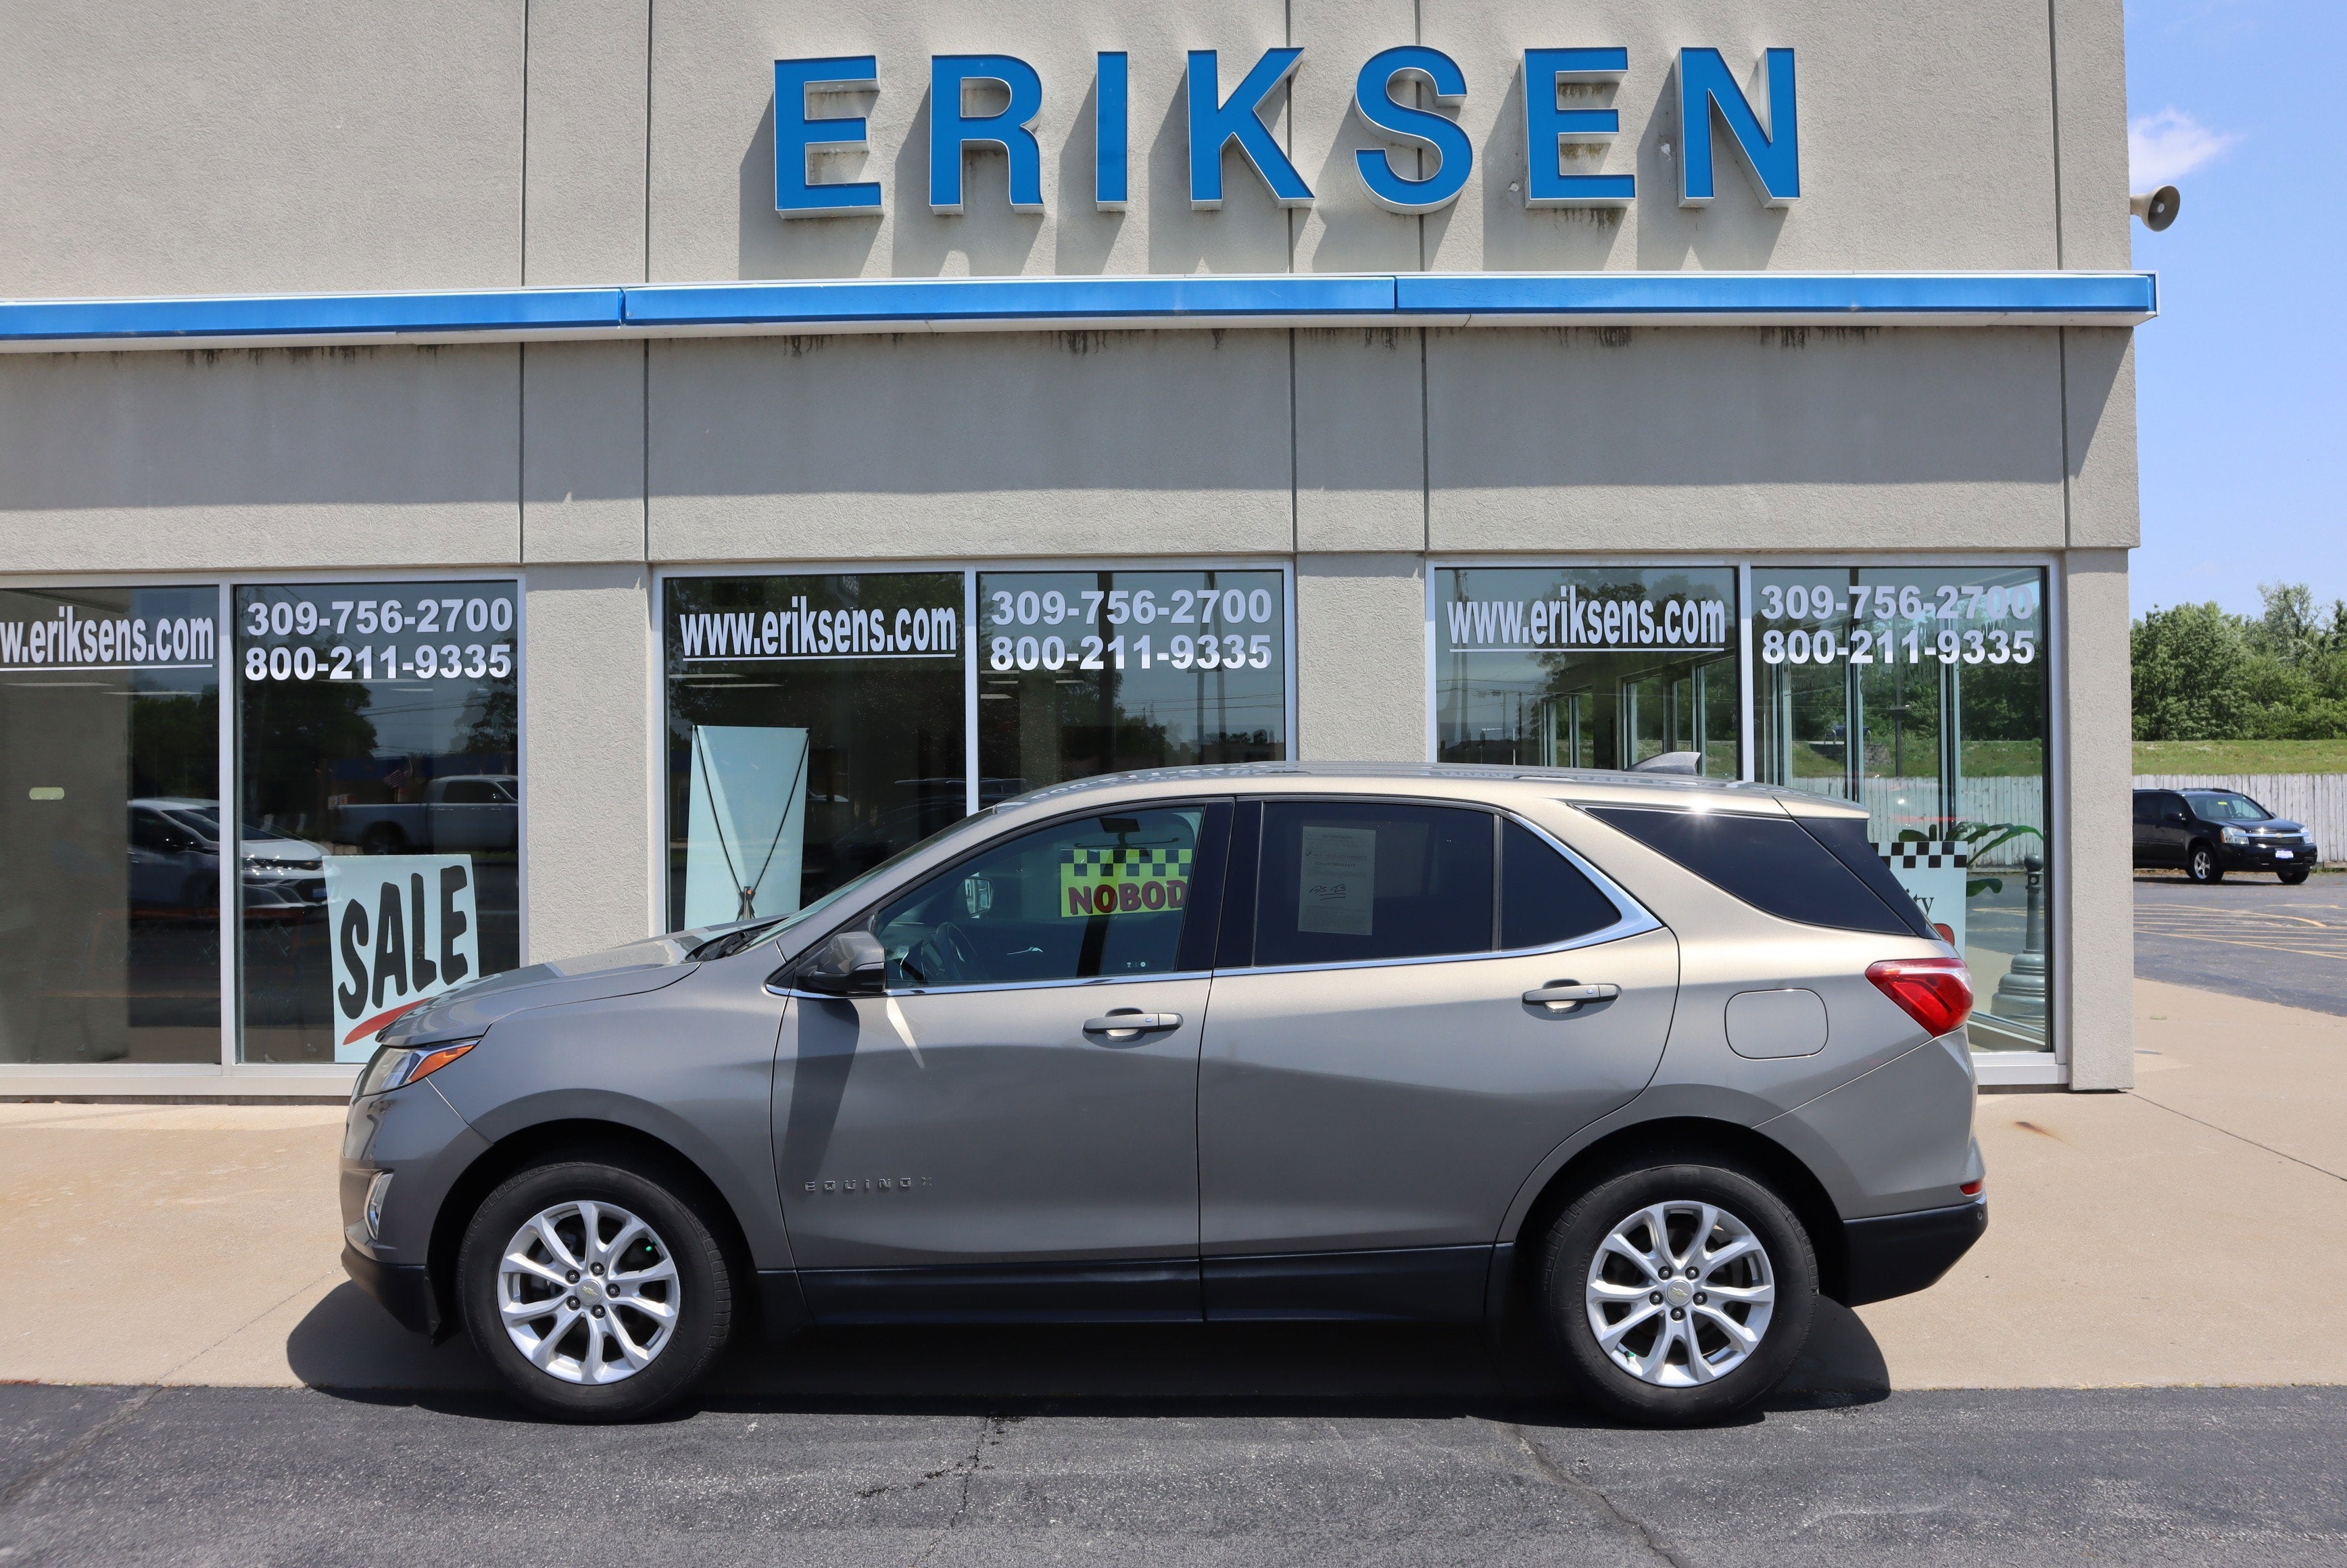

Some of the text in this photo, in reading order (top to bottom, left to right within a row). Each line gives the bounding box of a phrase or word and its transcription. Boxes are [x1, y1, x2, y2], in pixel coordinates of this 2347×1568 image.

[773, 45, 1802, 220] ERIKSEN
[247, 598, 514, 636] 309-756-2700
[991, 589, 1273, 627] 309-756-2700
[1447, 586, 1725, 645] www.eriksens.com
[1760, 585, 2034, 620] 309-756-2700
[679, 595, 957, 656] www.eriksens.com
[245, 645, 512, 681] 800-211-9335
[990, 634, 1272, 671] 800-211-9335
[1762, 629, 2035, 665] 800-211-9335
[337, 865, 468, 1020] SALE
[804, 1177, 931, 1192] EQUINOX
